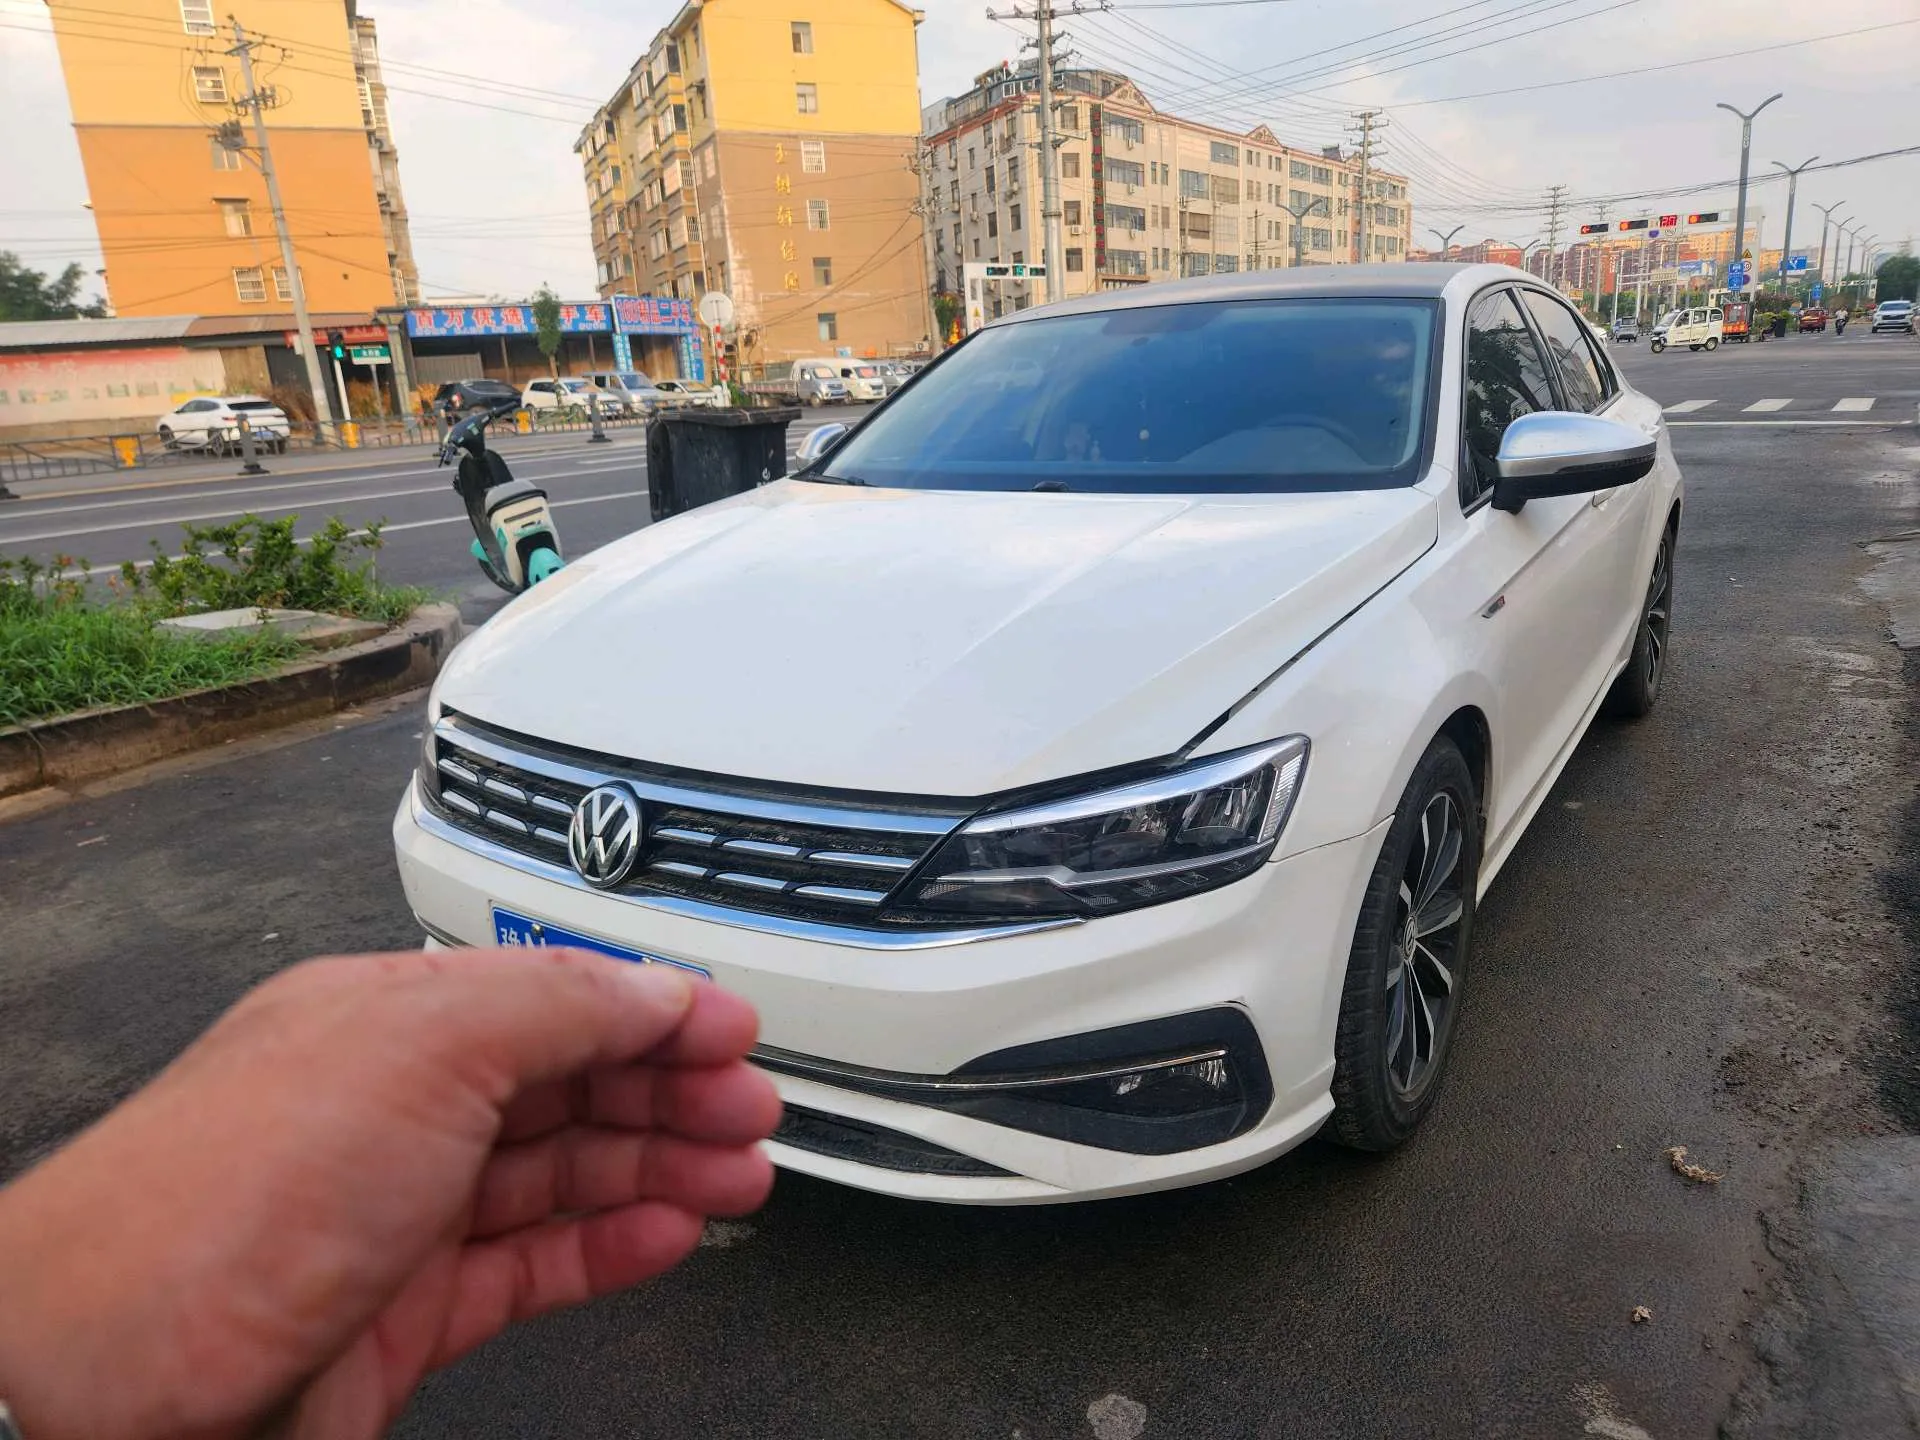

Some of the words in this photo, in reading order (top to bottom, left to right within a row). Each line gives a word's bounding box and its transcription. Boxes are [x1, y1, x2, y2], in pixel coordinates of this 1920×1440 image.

[412, 304, 607, 329] 百万优选手车
